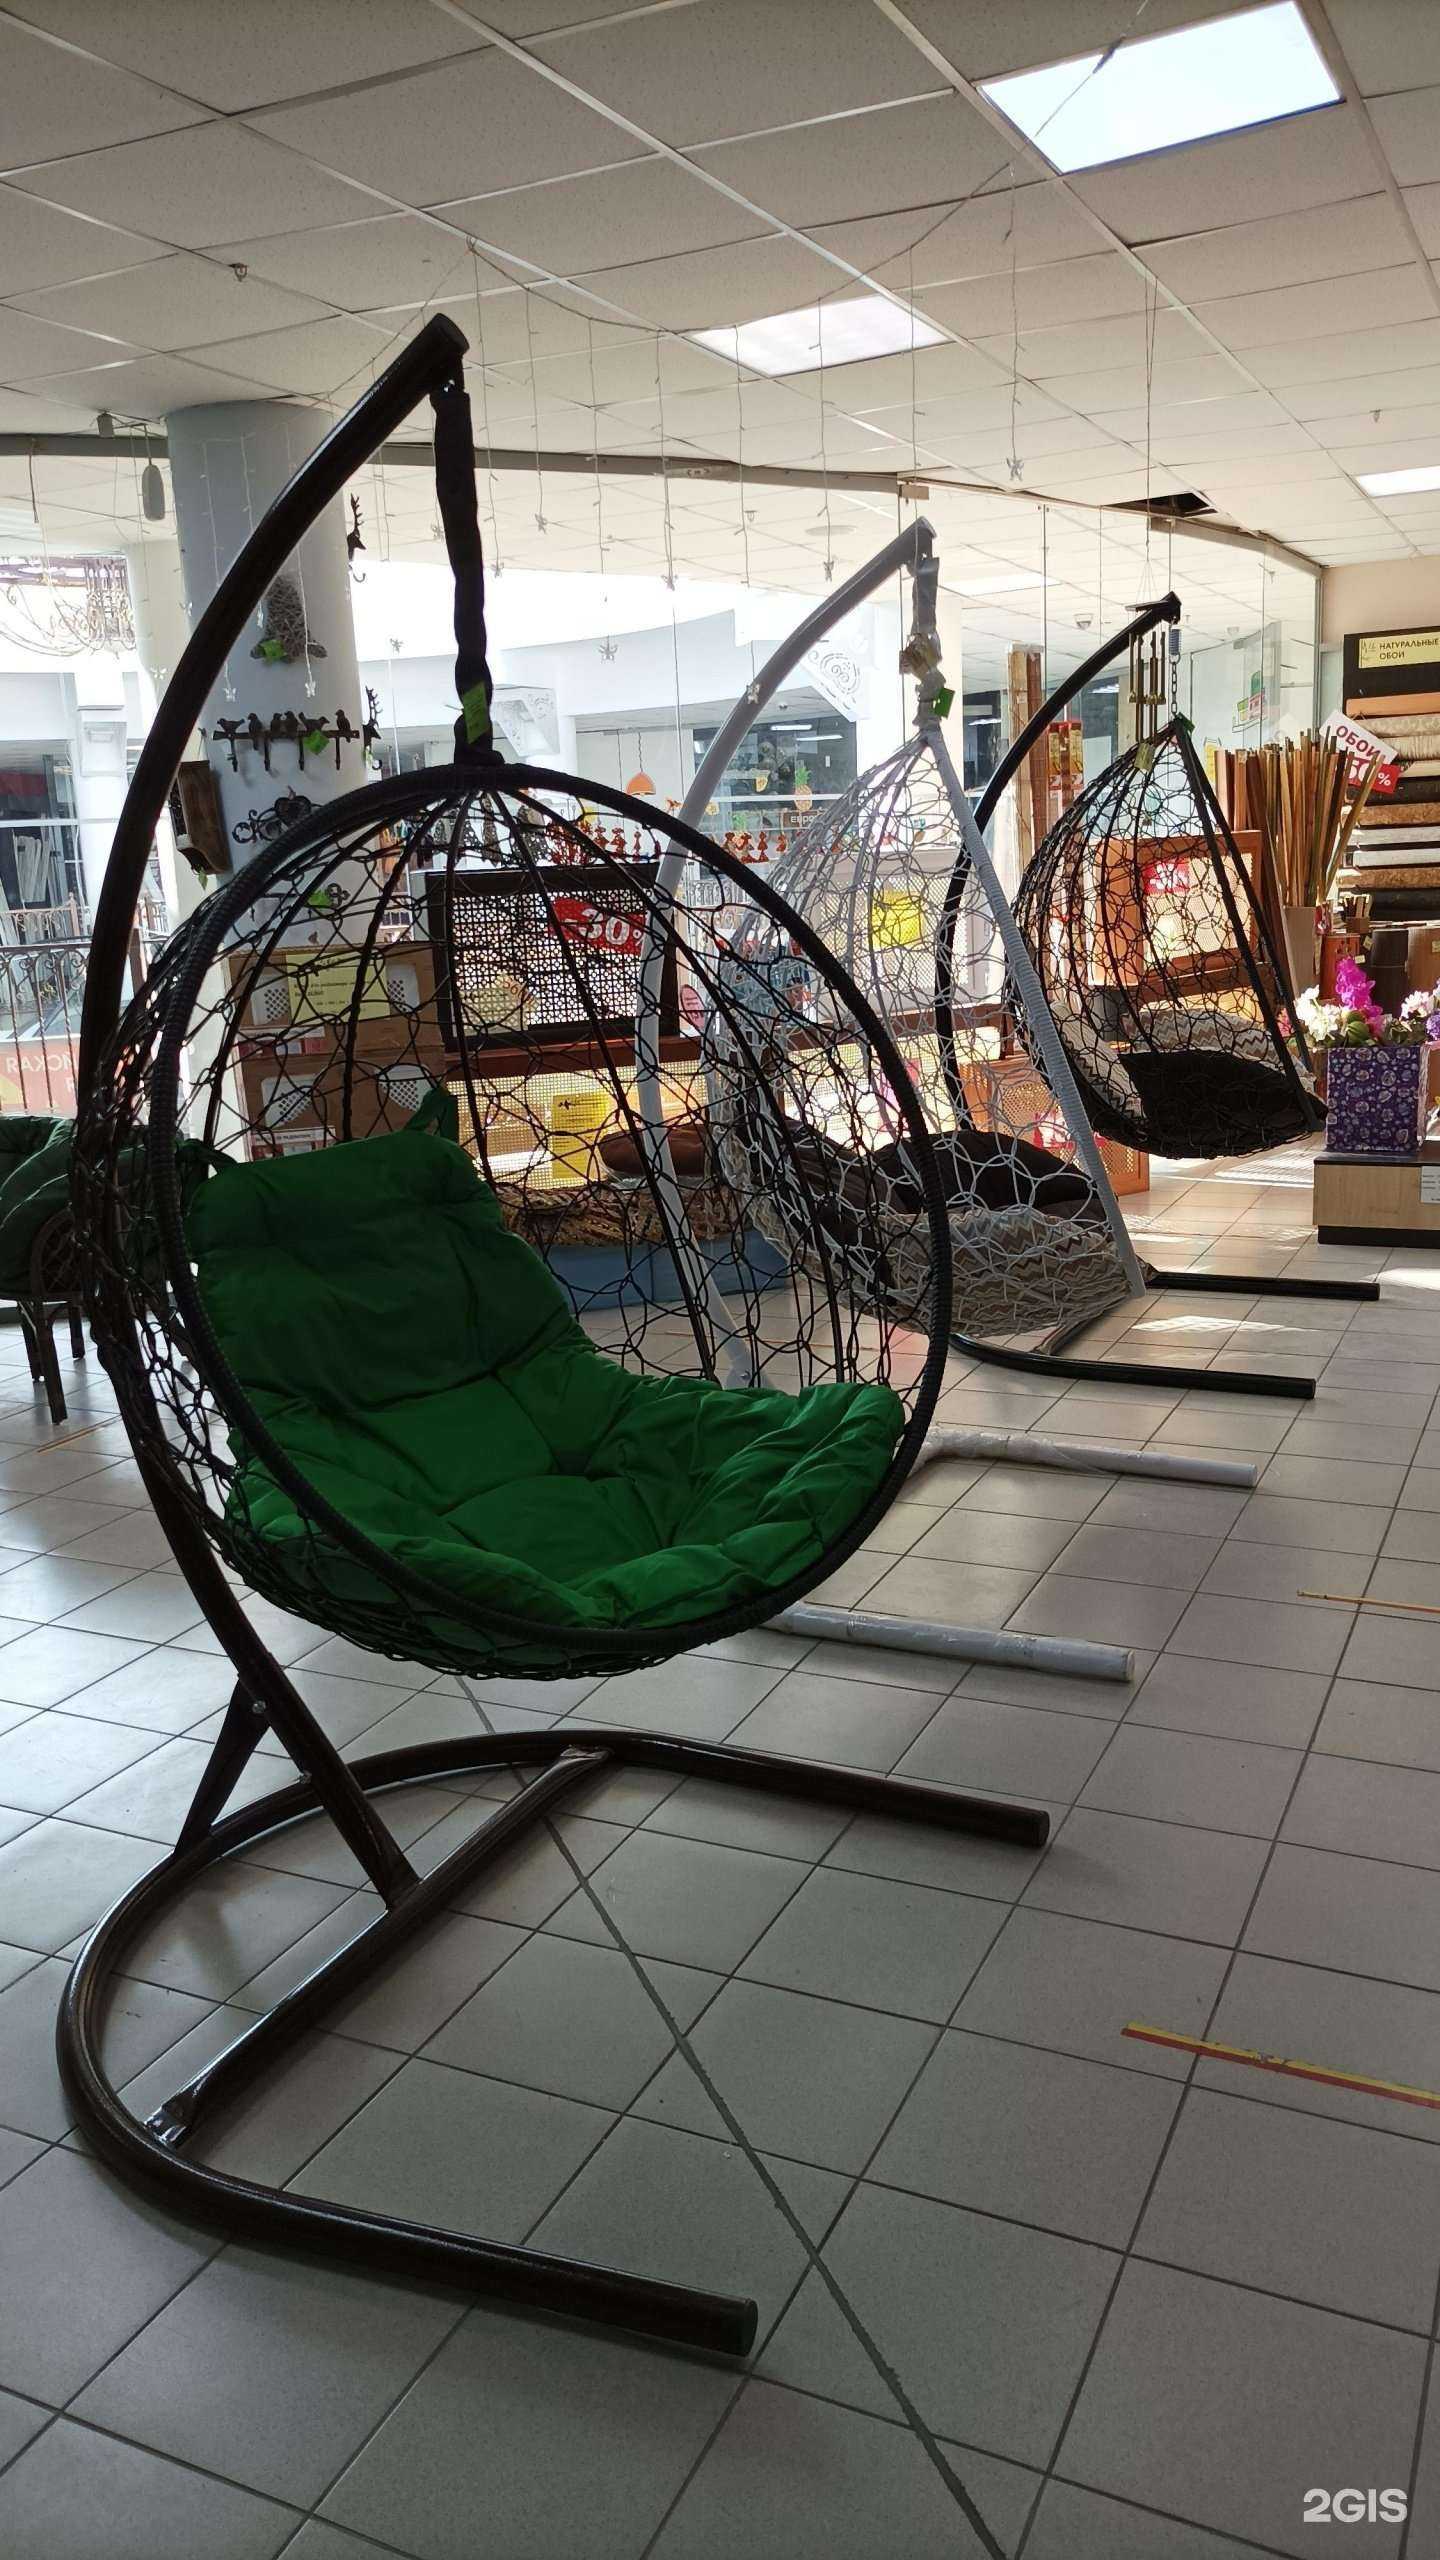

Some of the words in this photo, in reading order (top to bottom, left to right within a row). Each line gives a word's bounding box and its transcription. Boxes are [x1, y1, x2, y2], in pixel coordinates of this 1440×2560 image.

[1379, 638, 1439, 650] НАТУРАЛЬНЫЕ
[1379, 651, 1405, 661] ОБОИ
[1336, 725, 1381, 757] ОБОИ
